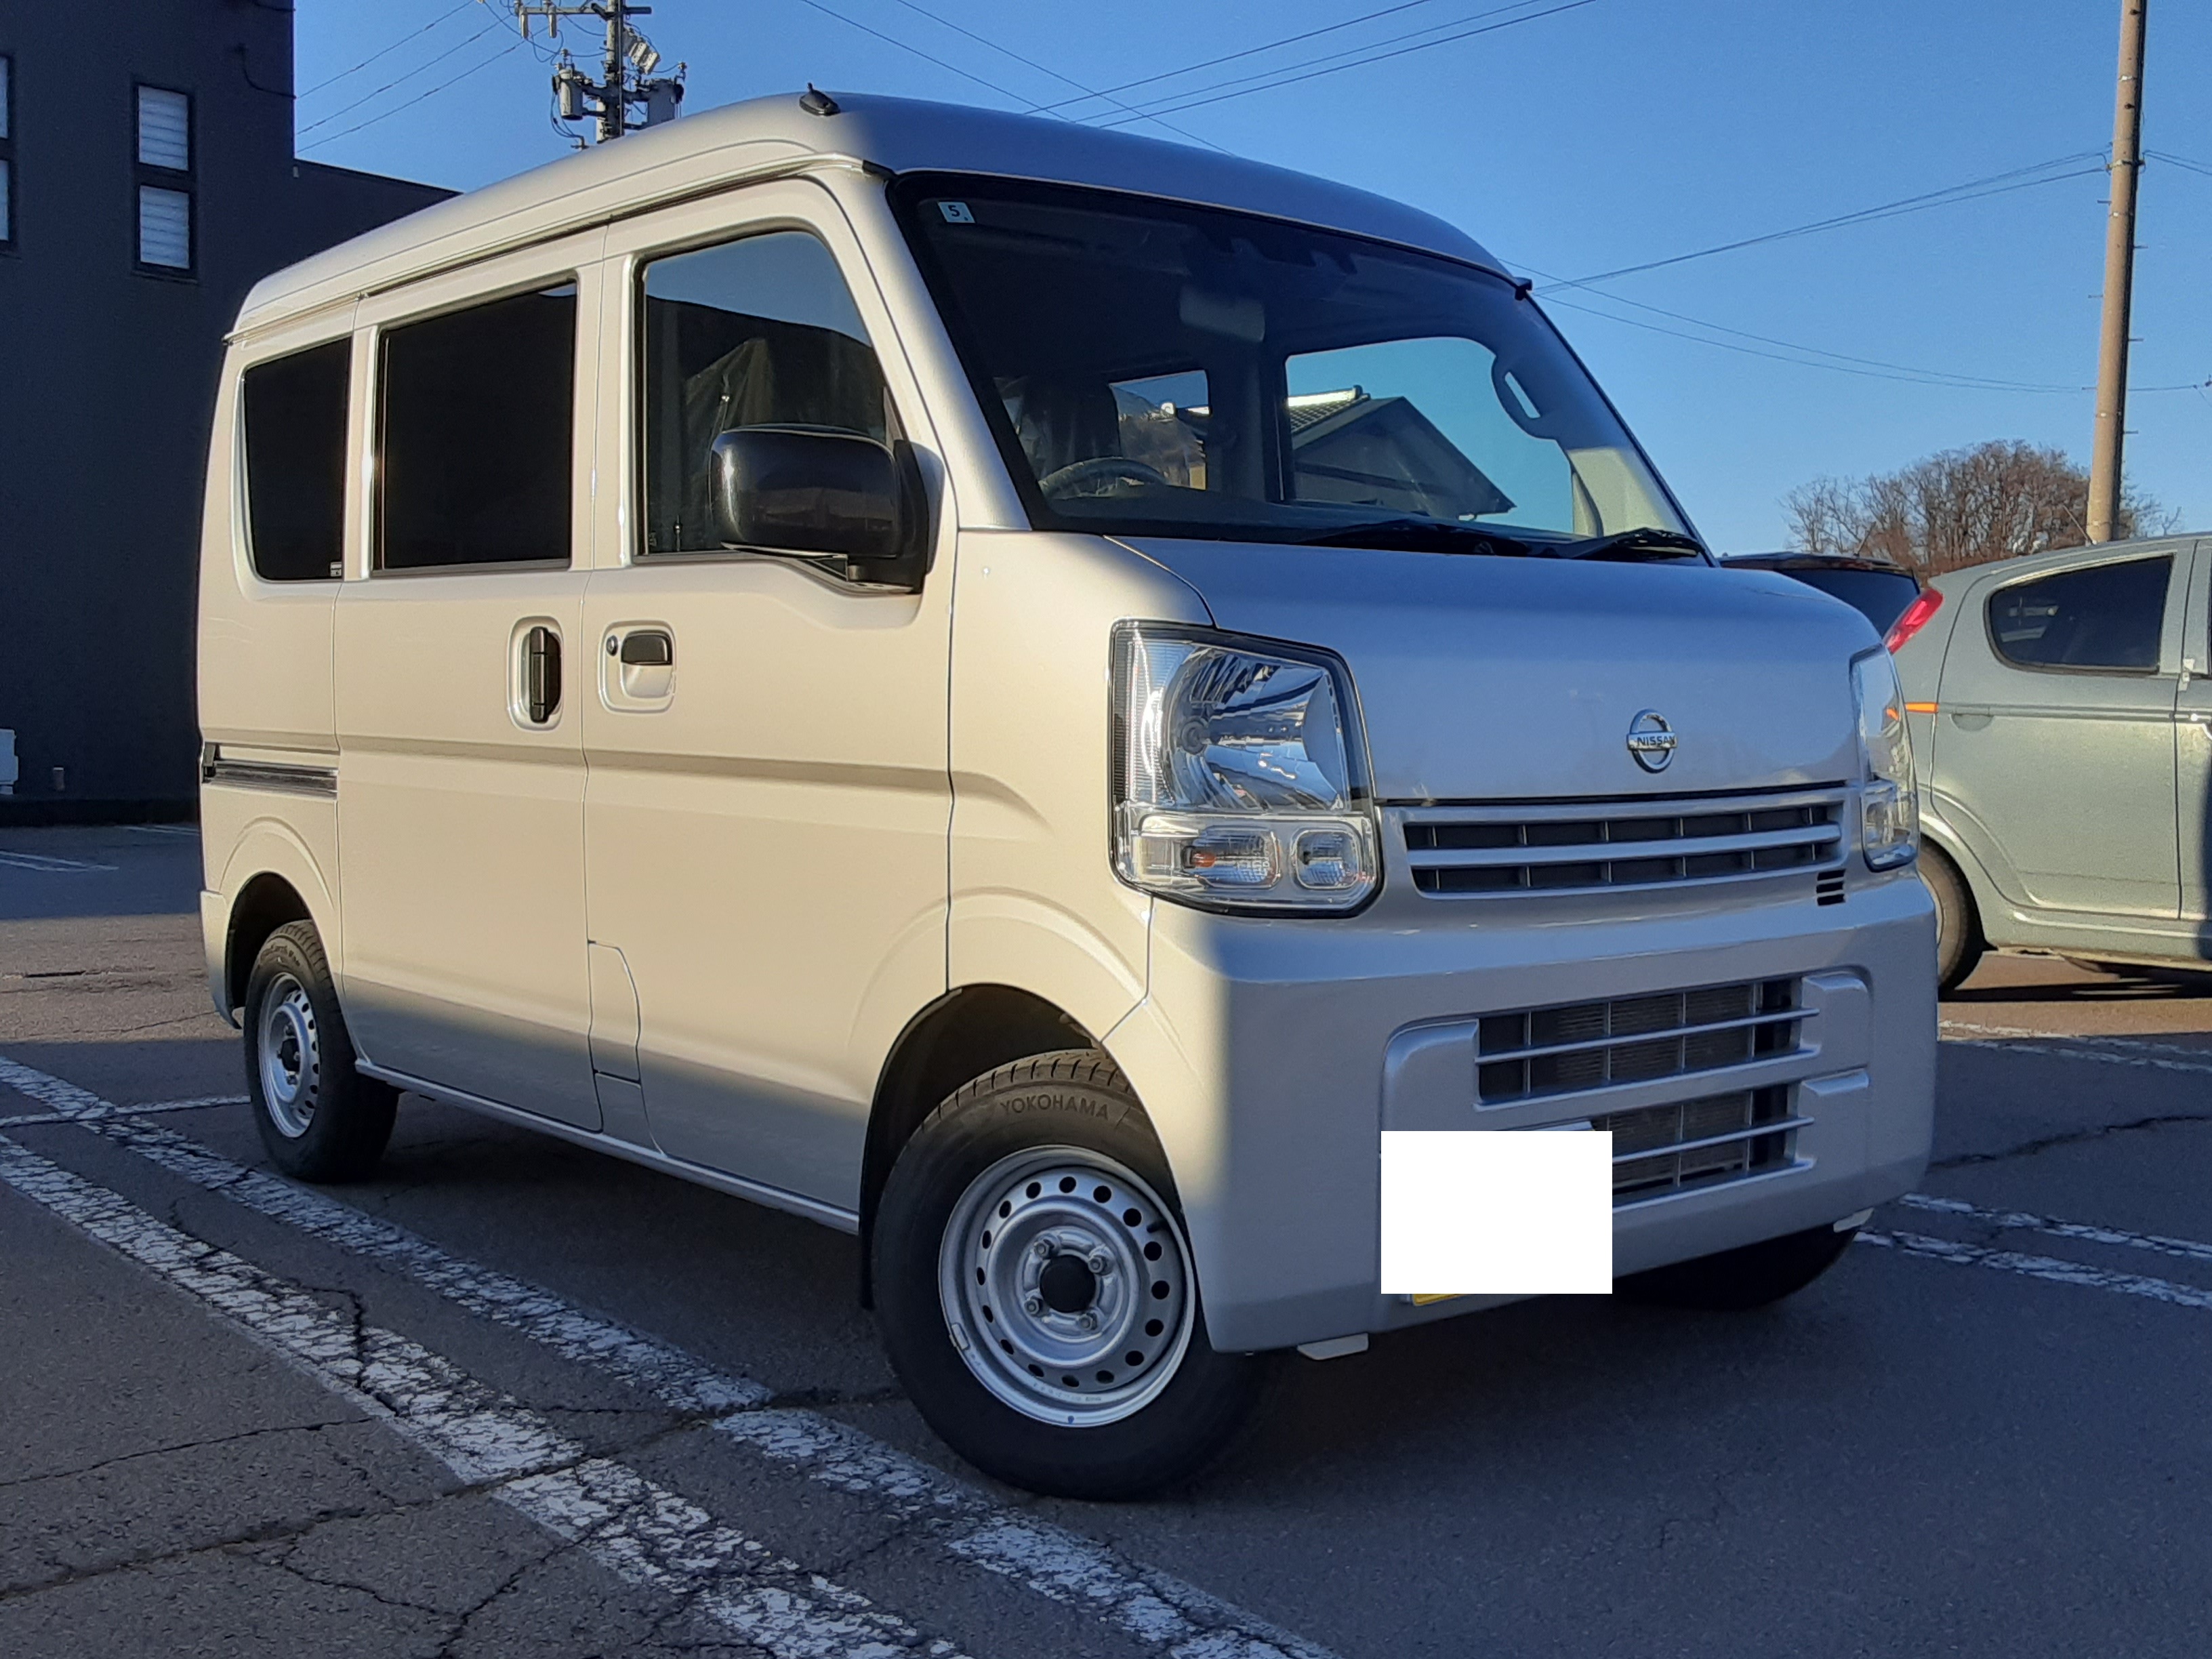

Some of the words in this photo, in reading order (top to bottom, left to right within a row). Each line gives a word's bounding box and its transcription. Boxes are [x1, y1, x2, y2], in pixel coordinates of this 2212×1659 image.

[947, 205, 960, 217] 5
[1637, 735, 1675, 746] NISSAN
[1000, 1094, 1109, 1120] YOKOHAMA
